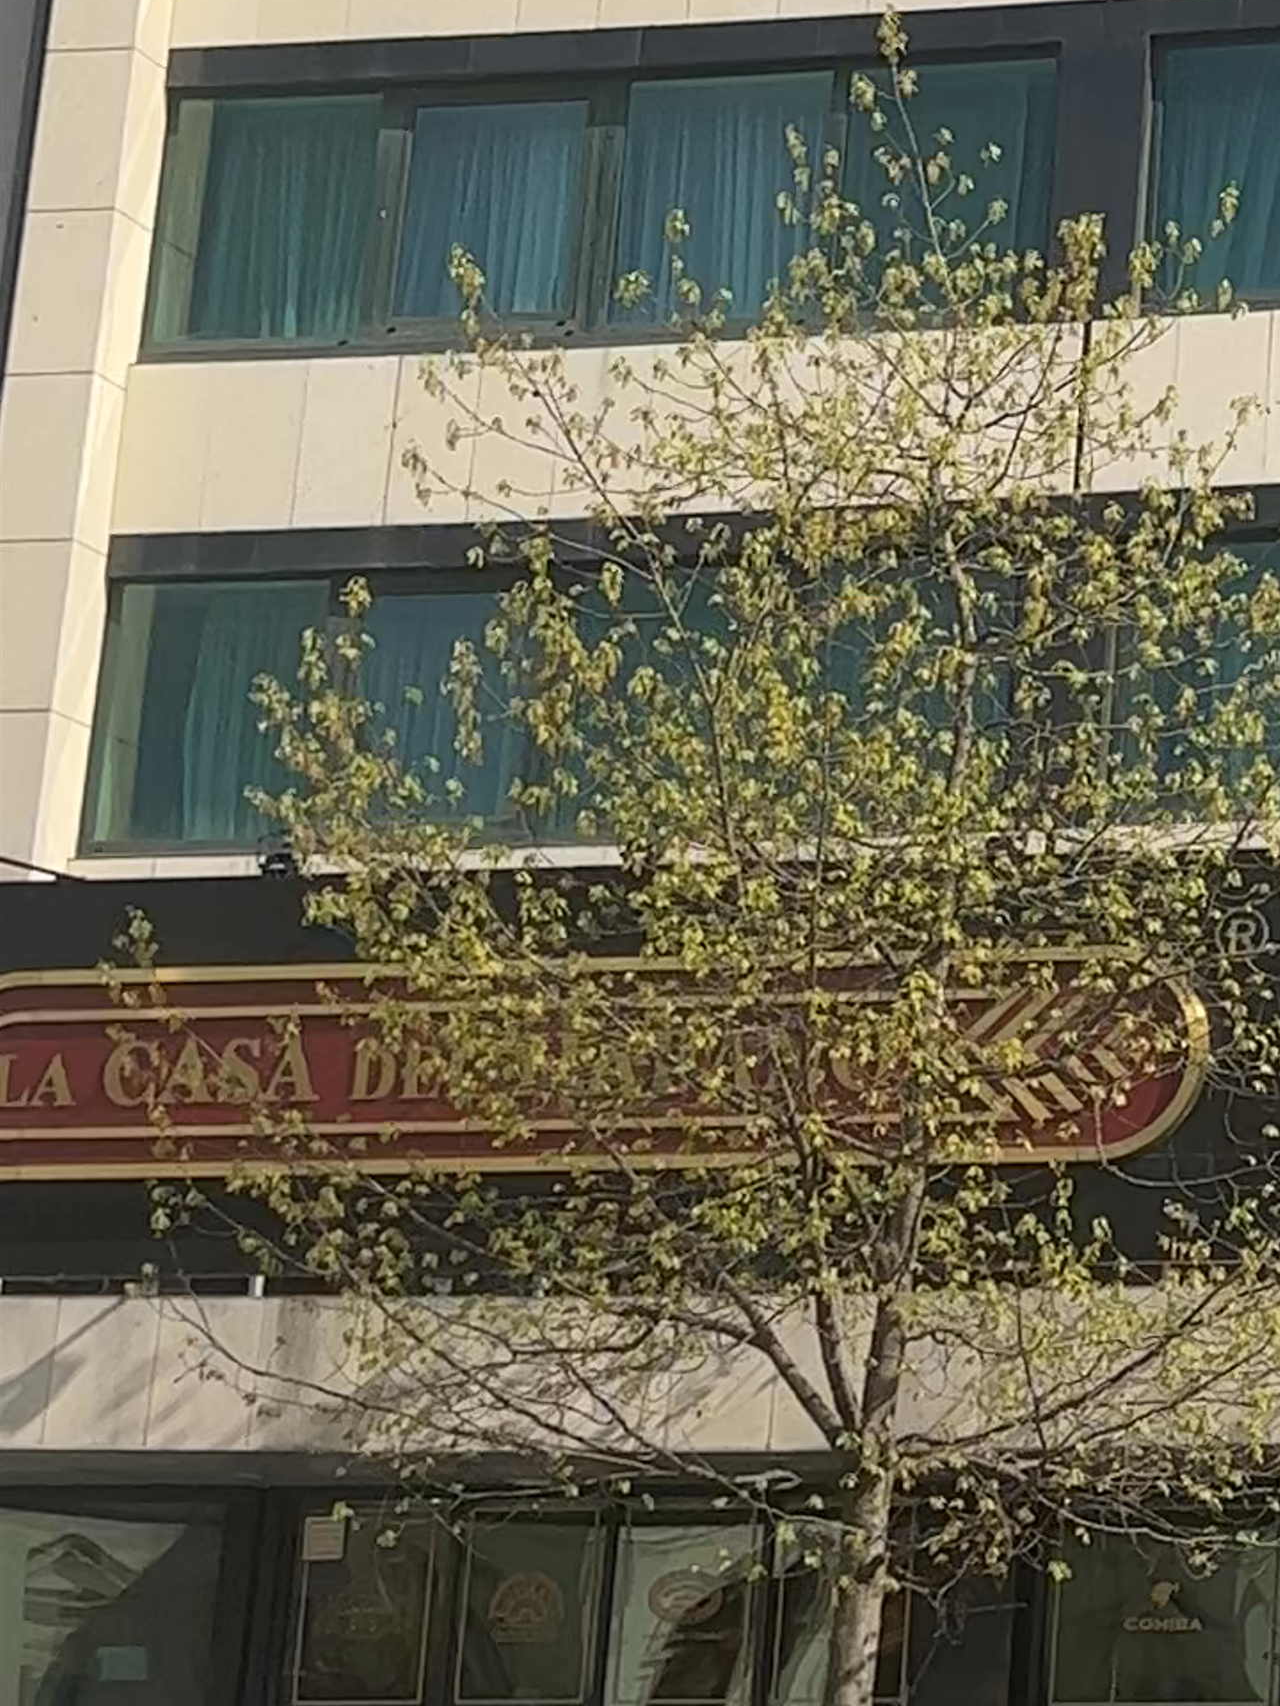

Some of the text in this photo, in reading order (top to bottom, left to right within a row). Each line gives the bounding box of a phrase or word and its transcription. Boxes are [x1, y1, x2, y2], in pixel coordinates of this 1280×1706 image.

[0, 1052, 76, 1108] LA
[103, 1035, 320, 1107] CASA
[1122, 1616, 1203, 1632] COHIBA
